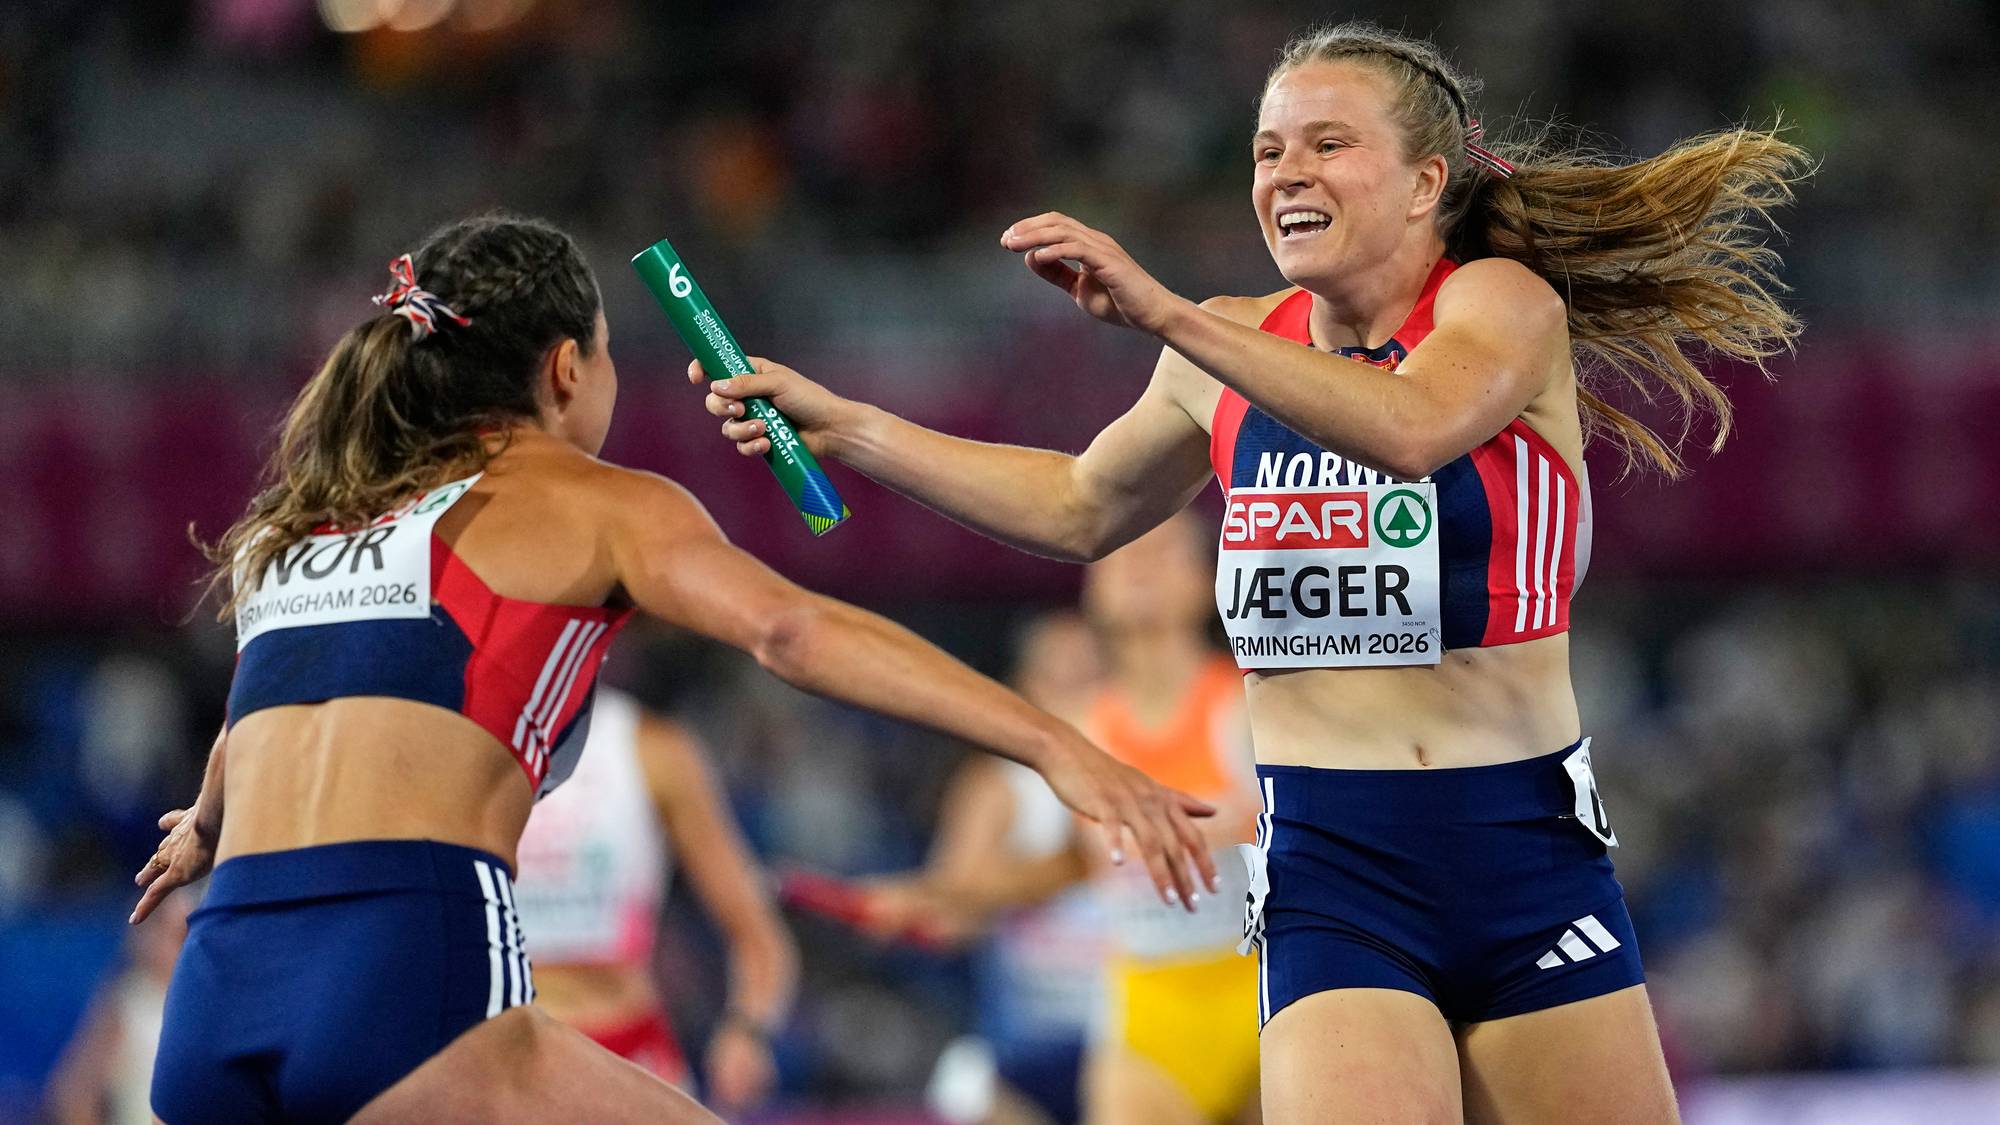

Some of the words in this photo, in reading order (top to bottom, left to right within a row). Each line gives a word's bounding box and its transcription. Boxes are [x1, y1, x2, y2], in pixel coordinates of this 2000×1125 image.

[668, 262, 692, 298] 6
[693, 314, 720, 350] ATHLETICS
[701, 309, 750, 374] AMPIONSHIPS
[715, 349, 738, 378] ROPEAN
[764, 407, 799, 450] 2026
[1255, 451, 1430, 488] NORW
[1225, 500, 1363, 542] SPAR
[256, 525, 397, 592] NOR
[359, 583, 416, 606] 2026
[1226, 564, 1413, 620] JÆGER
[1230, 634, 1361, 657] IRMINGHAM
[1367, 632, 1429, 654] 2026
